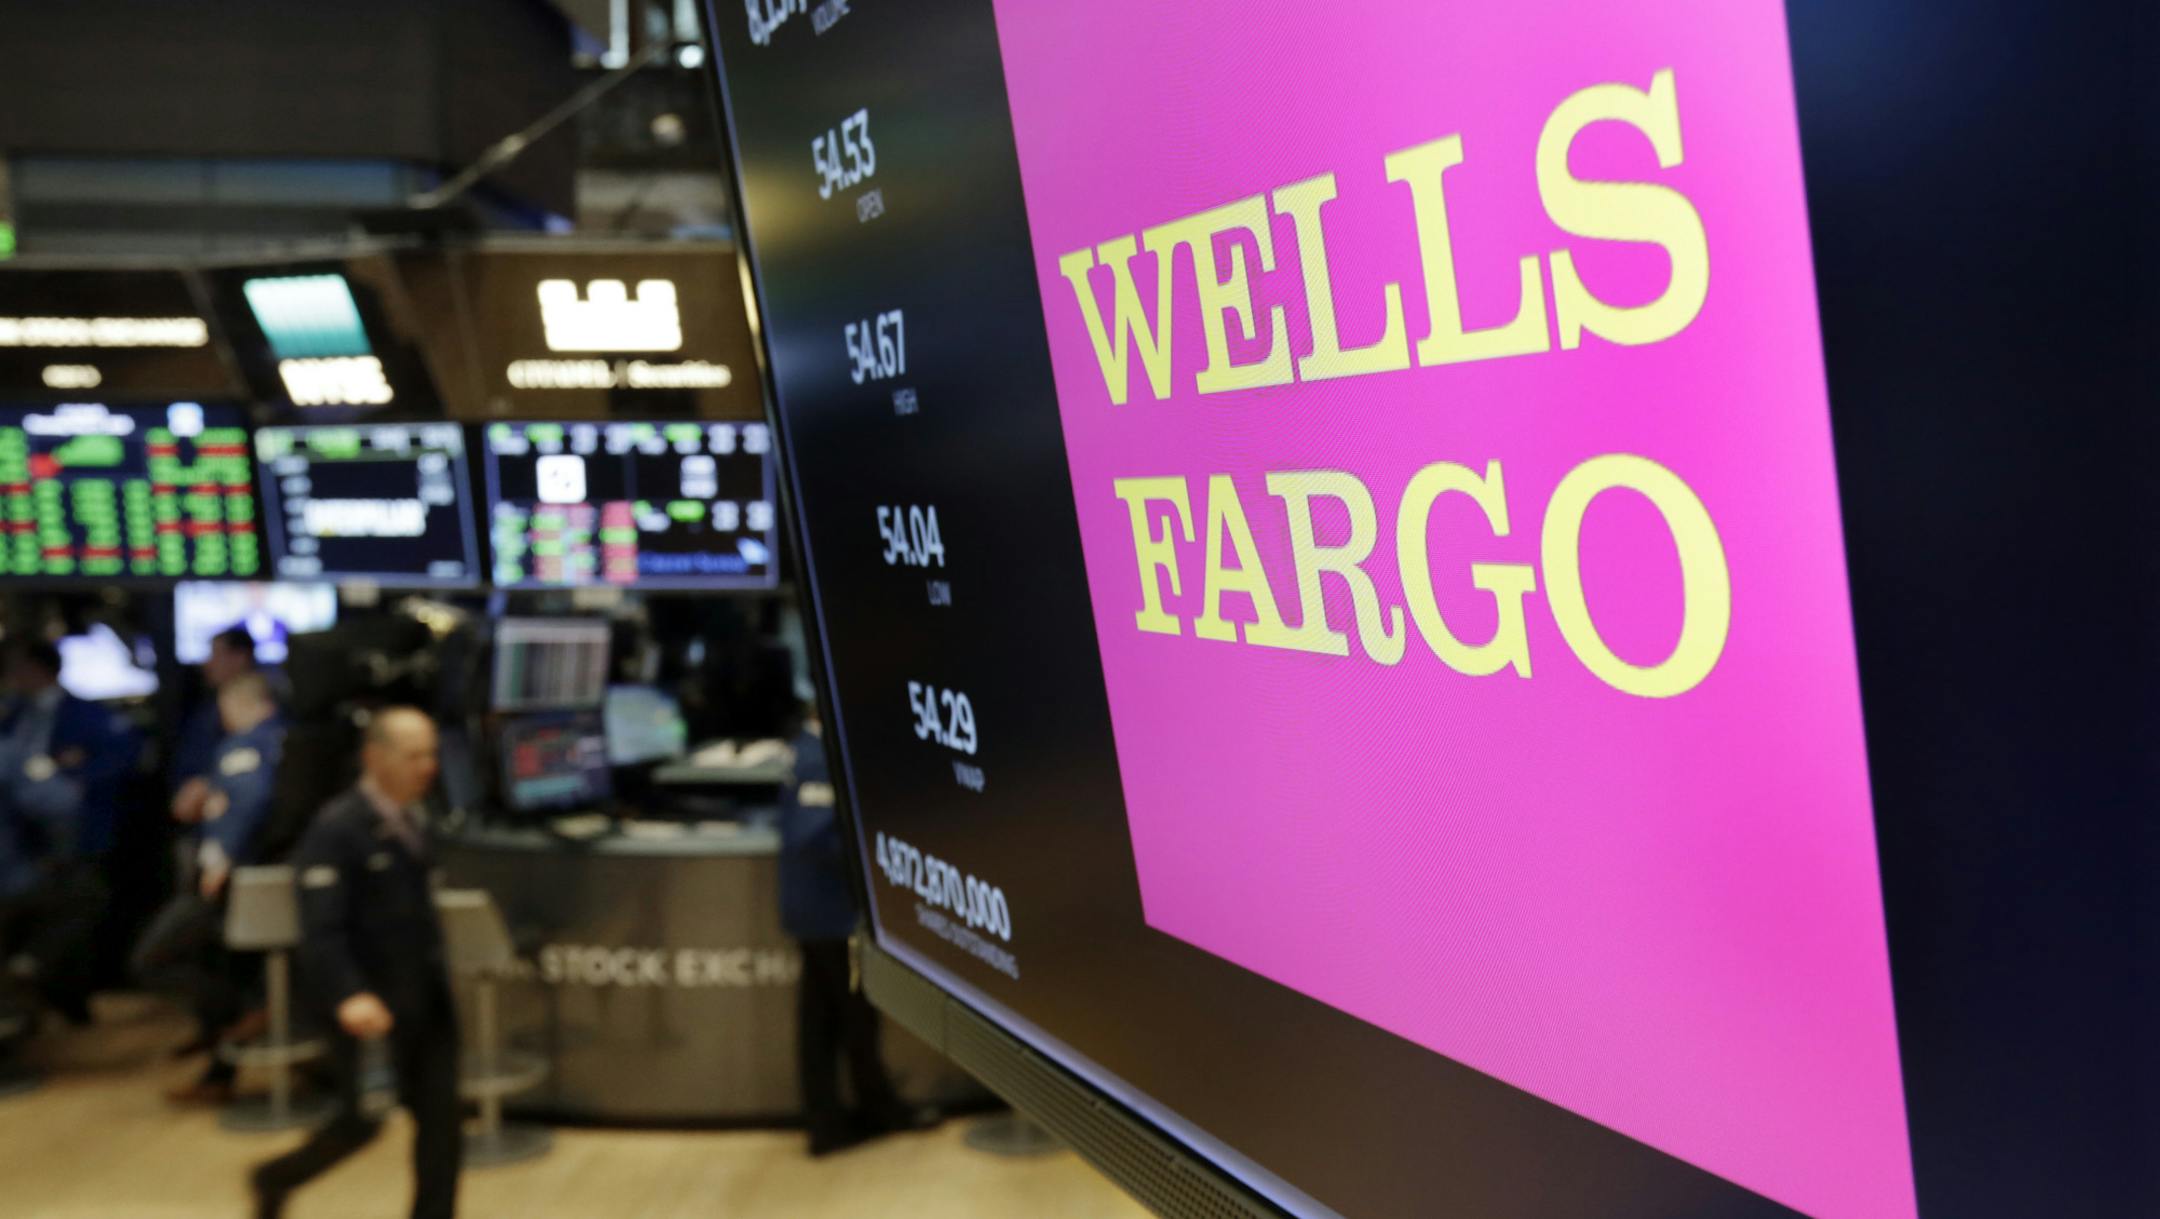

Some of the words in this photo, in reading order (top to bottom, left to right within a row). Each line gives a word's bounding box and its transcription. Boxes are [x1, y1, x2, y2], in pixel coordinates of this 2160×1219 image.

[811, 107, 876, 199] 54.53
[1058, 67, 1710, 405] WELLS
[844, 309, 906, 385] 54.67
[877, 504, 945, 568] 54.04
[1113, 453, 1731, 699] FARGO
[907, 679, 978, 755] 54.29
